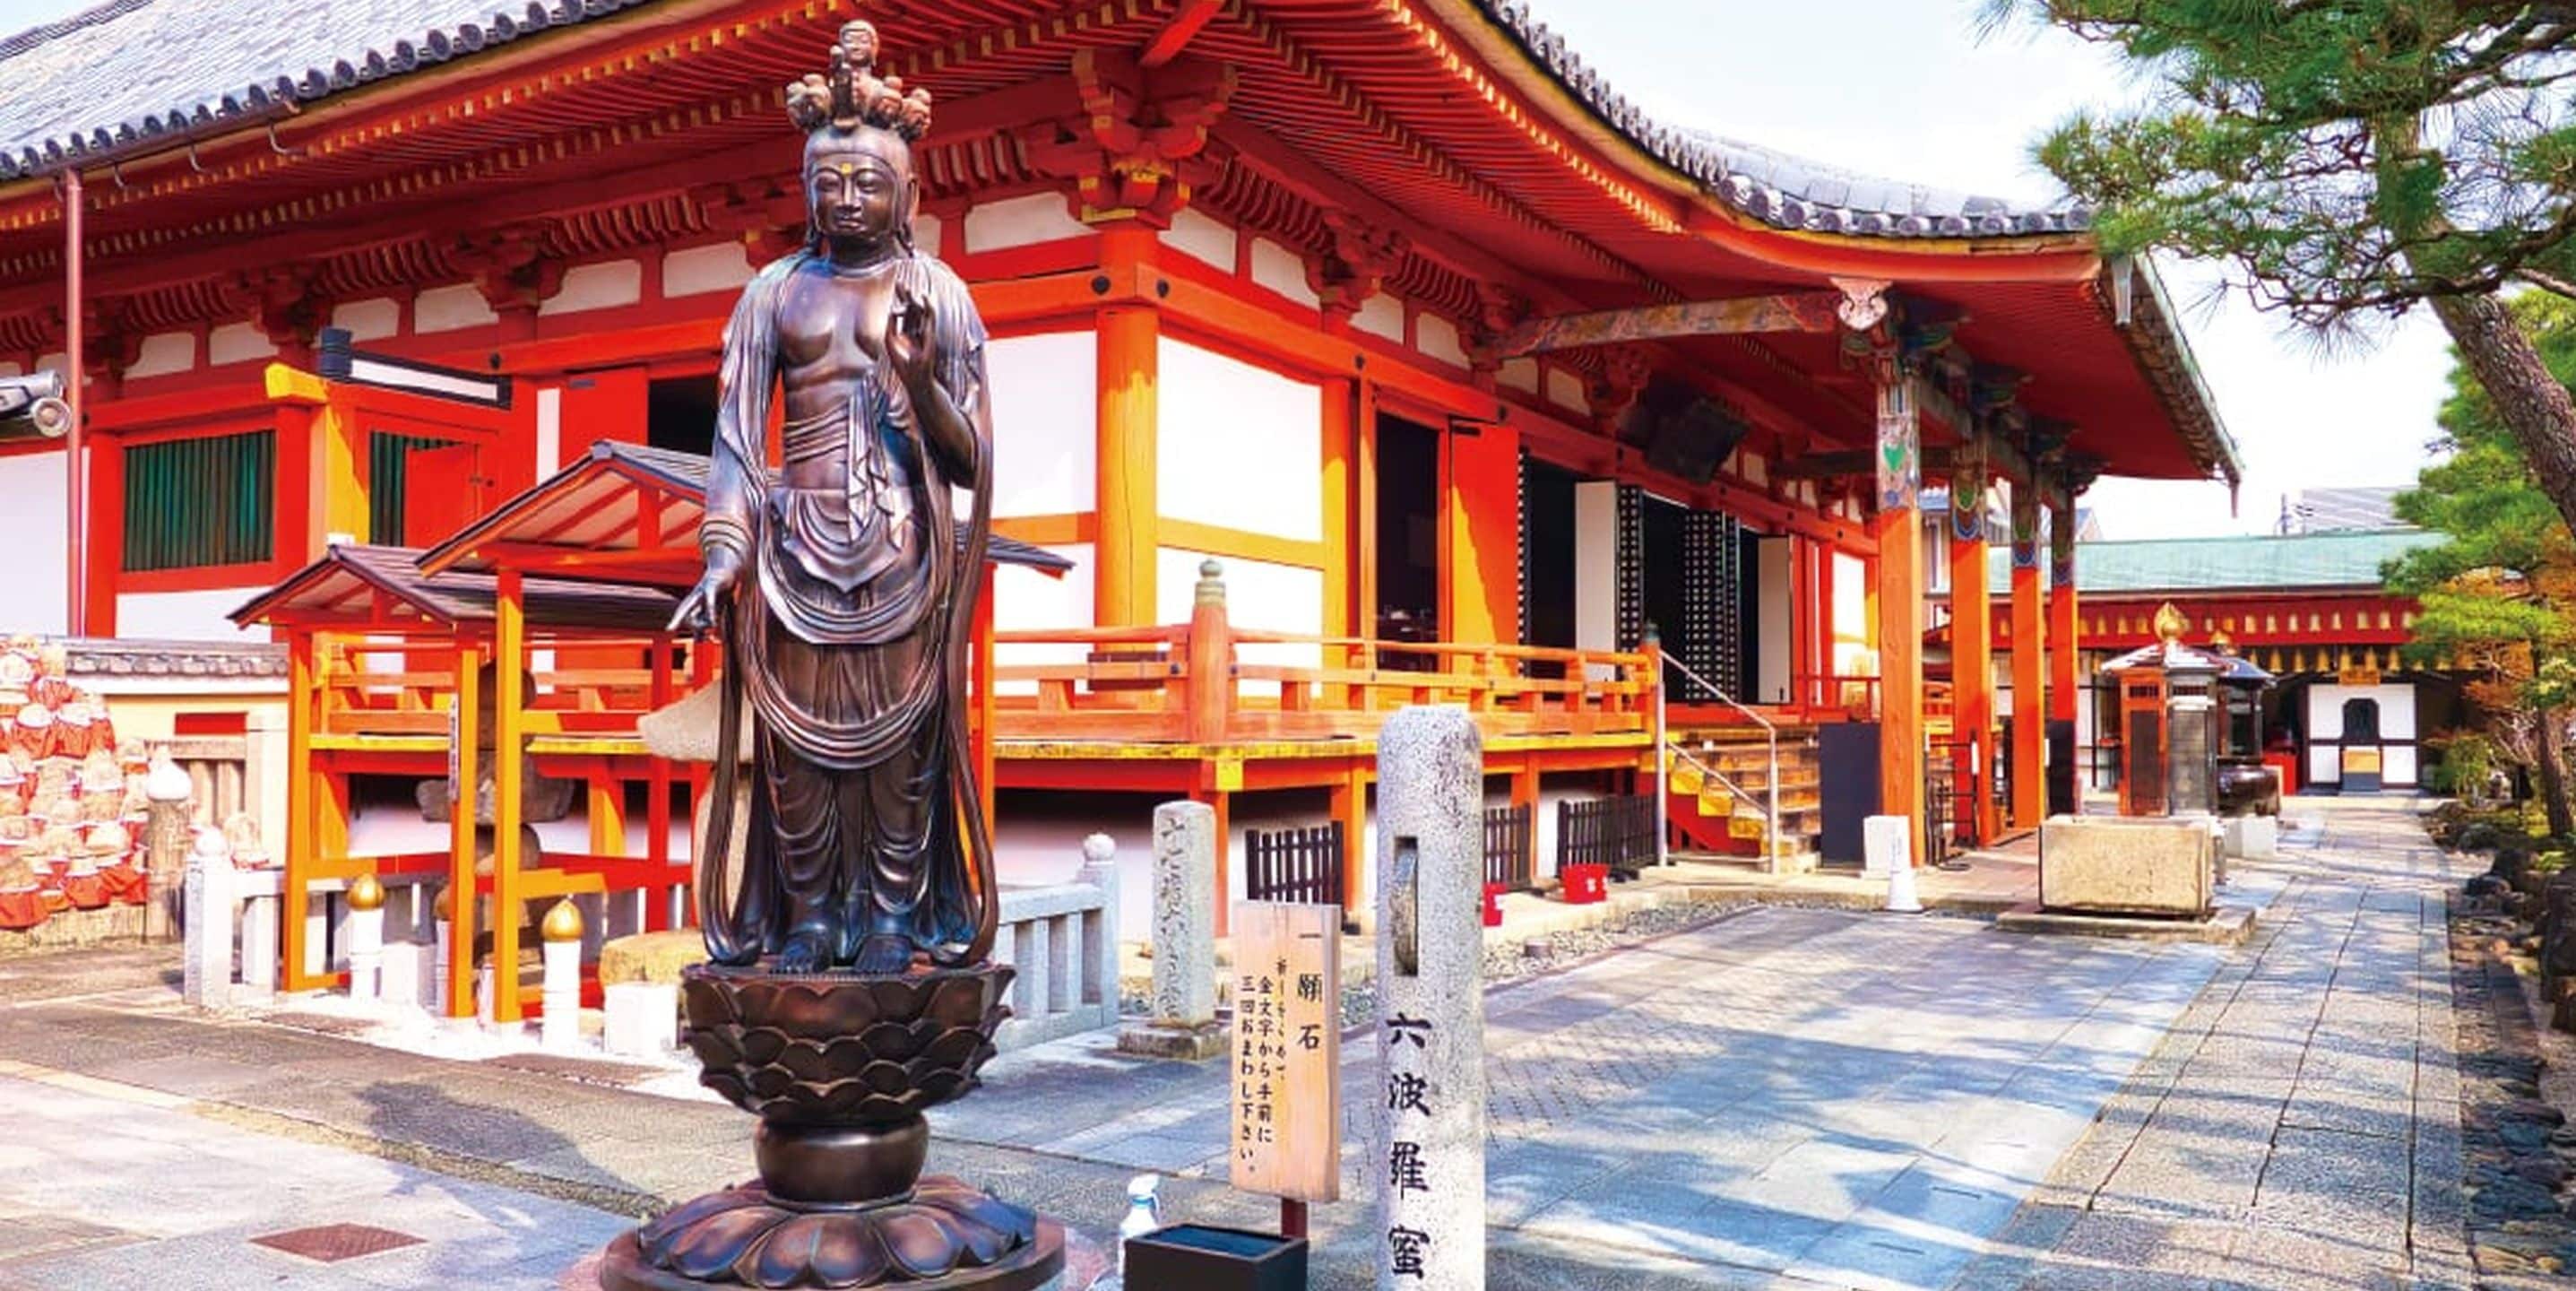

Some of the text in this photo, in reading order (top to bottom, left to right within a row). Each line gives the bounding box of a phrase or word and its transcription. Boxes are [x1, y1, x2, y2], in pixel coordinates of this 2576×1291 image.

[1257, 975, 1274, 1144] 金文字から手前に
[1297, 931, 1323, 1051] 一願石
[1386, 1012, 1432, 1280] 六波羅蜜
